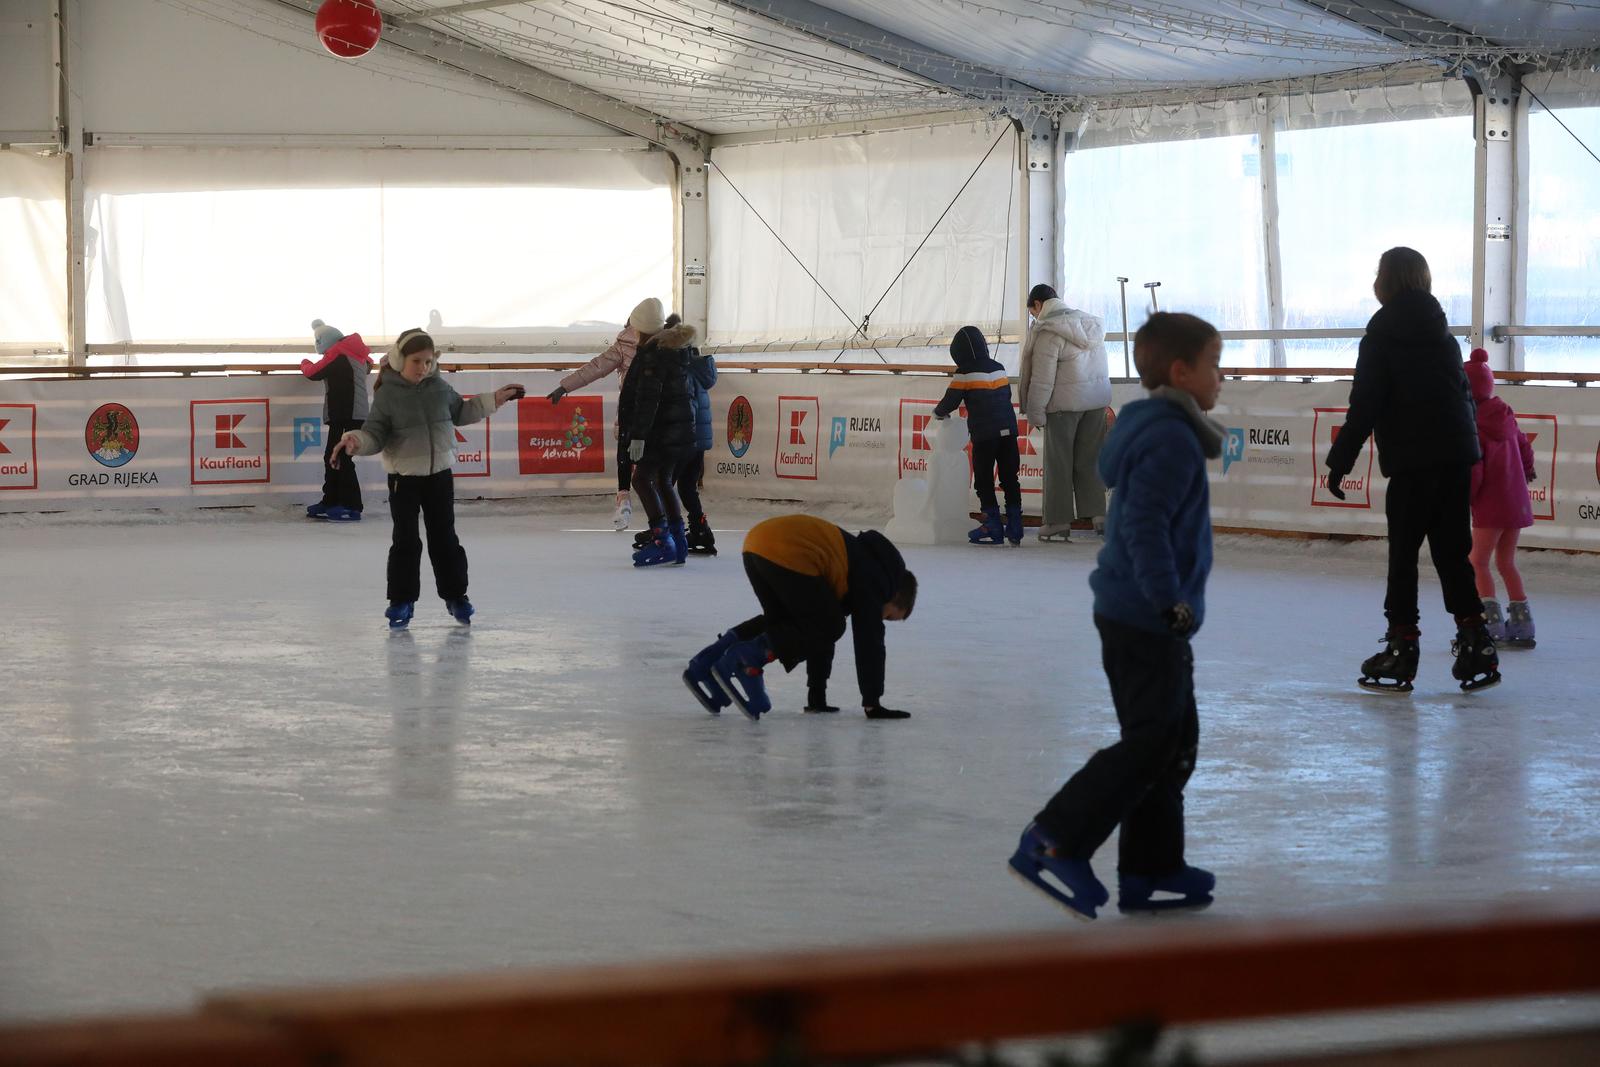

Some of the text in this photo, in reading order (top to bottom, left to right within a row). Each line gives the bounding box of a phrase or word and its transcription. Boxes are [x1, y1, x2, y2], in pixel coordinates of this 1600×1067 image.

[849, 416, 881, 432] RIJEKA
[529, 437, 562, 450] Rijeka
[1249, 428, 1290, 446] RIJEKA
[542, 446, 587, 462] Advent
[779, 452, 813, 466] Kaufland
[200, 456, 262, 470] Kaufland
[716, 462, 760, 478] GRAD RIJEKA
[902, 457, 928, 472] Kaufl
[68, 471, 159, 488] GRAD RIJEKA
[1319, 474, 1364, 491] Kland
[1578, 504, 1600, 521] GRA
